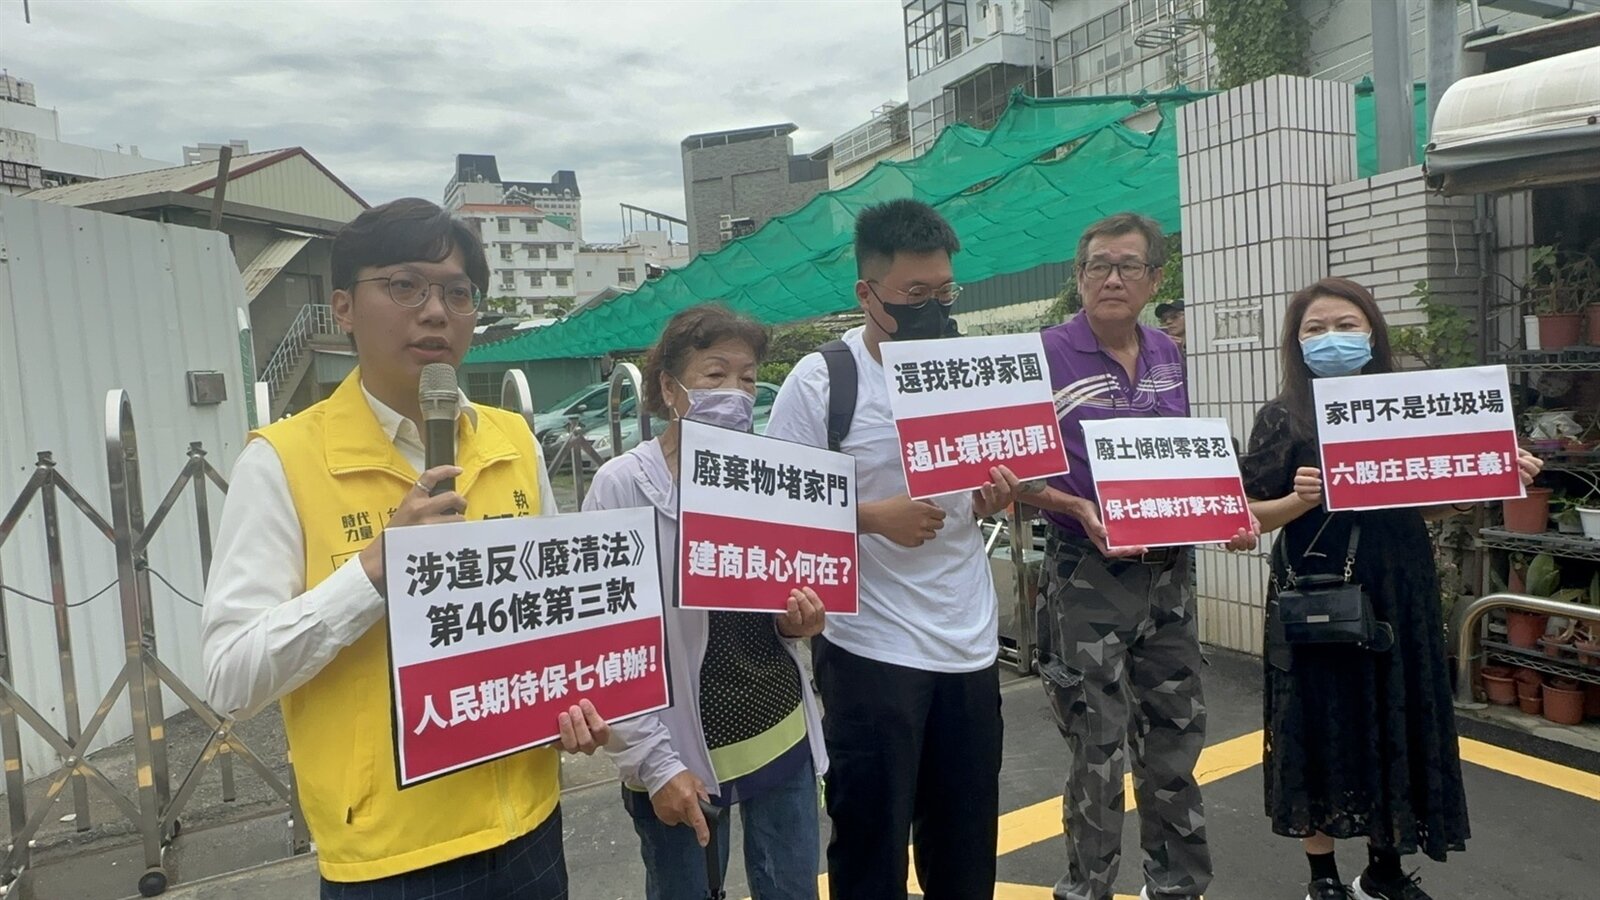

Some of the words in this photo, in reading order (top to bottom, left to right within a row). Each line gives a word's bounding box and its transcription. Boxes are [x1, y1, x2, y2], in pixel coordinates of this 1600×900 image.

[894, 353, 1043, 395] 還我乾淨家園
[1325, 389, 1504, 426] 家門不是垃圾場
[1094, 437, 1231, 461] 廢土傾倒零容忍
[1330, 451, 1512, 486] 六股庄民要正義!
[692, 449, 849, 507] 廢棄物堵家門
[341, 511, 372, 529] 時代
[345, 525, 374, 543] 力量
[405, 529, 646, 598] 涉違反《廢清法》
[688, 540, 852, 586] 建商良心何在?
[426, 576, 638, 648] 第46條第三款
